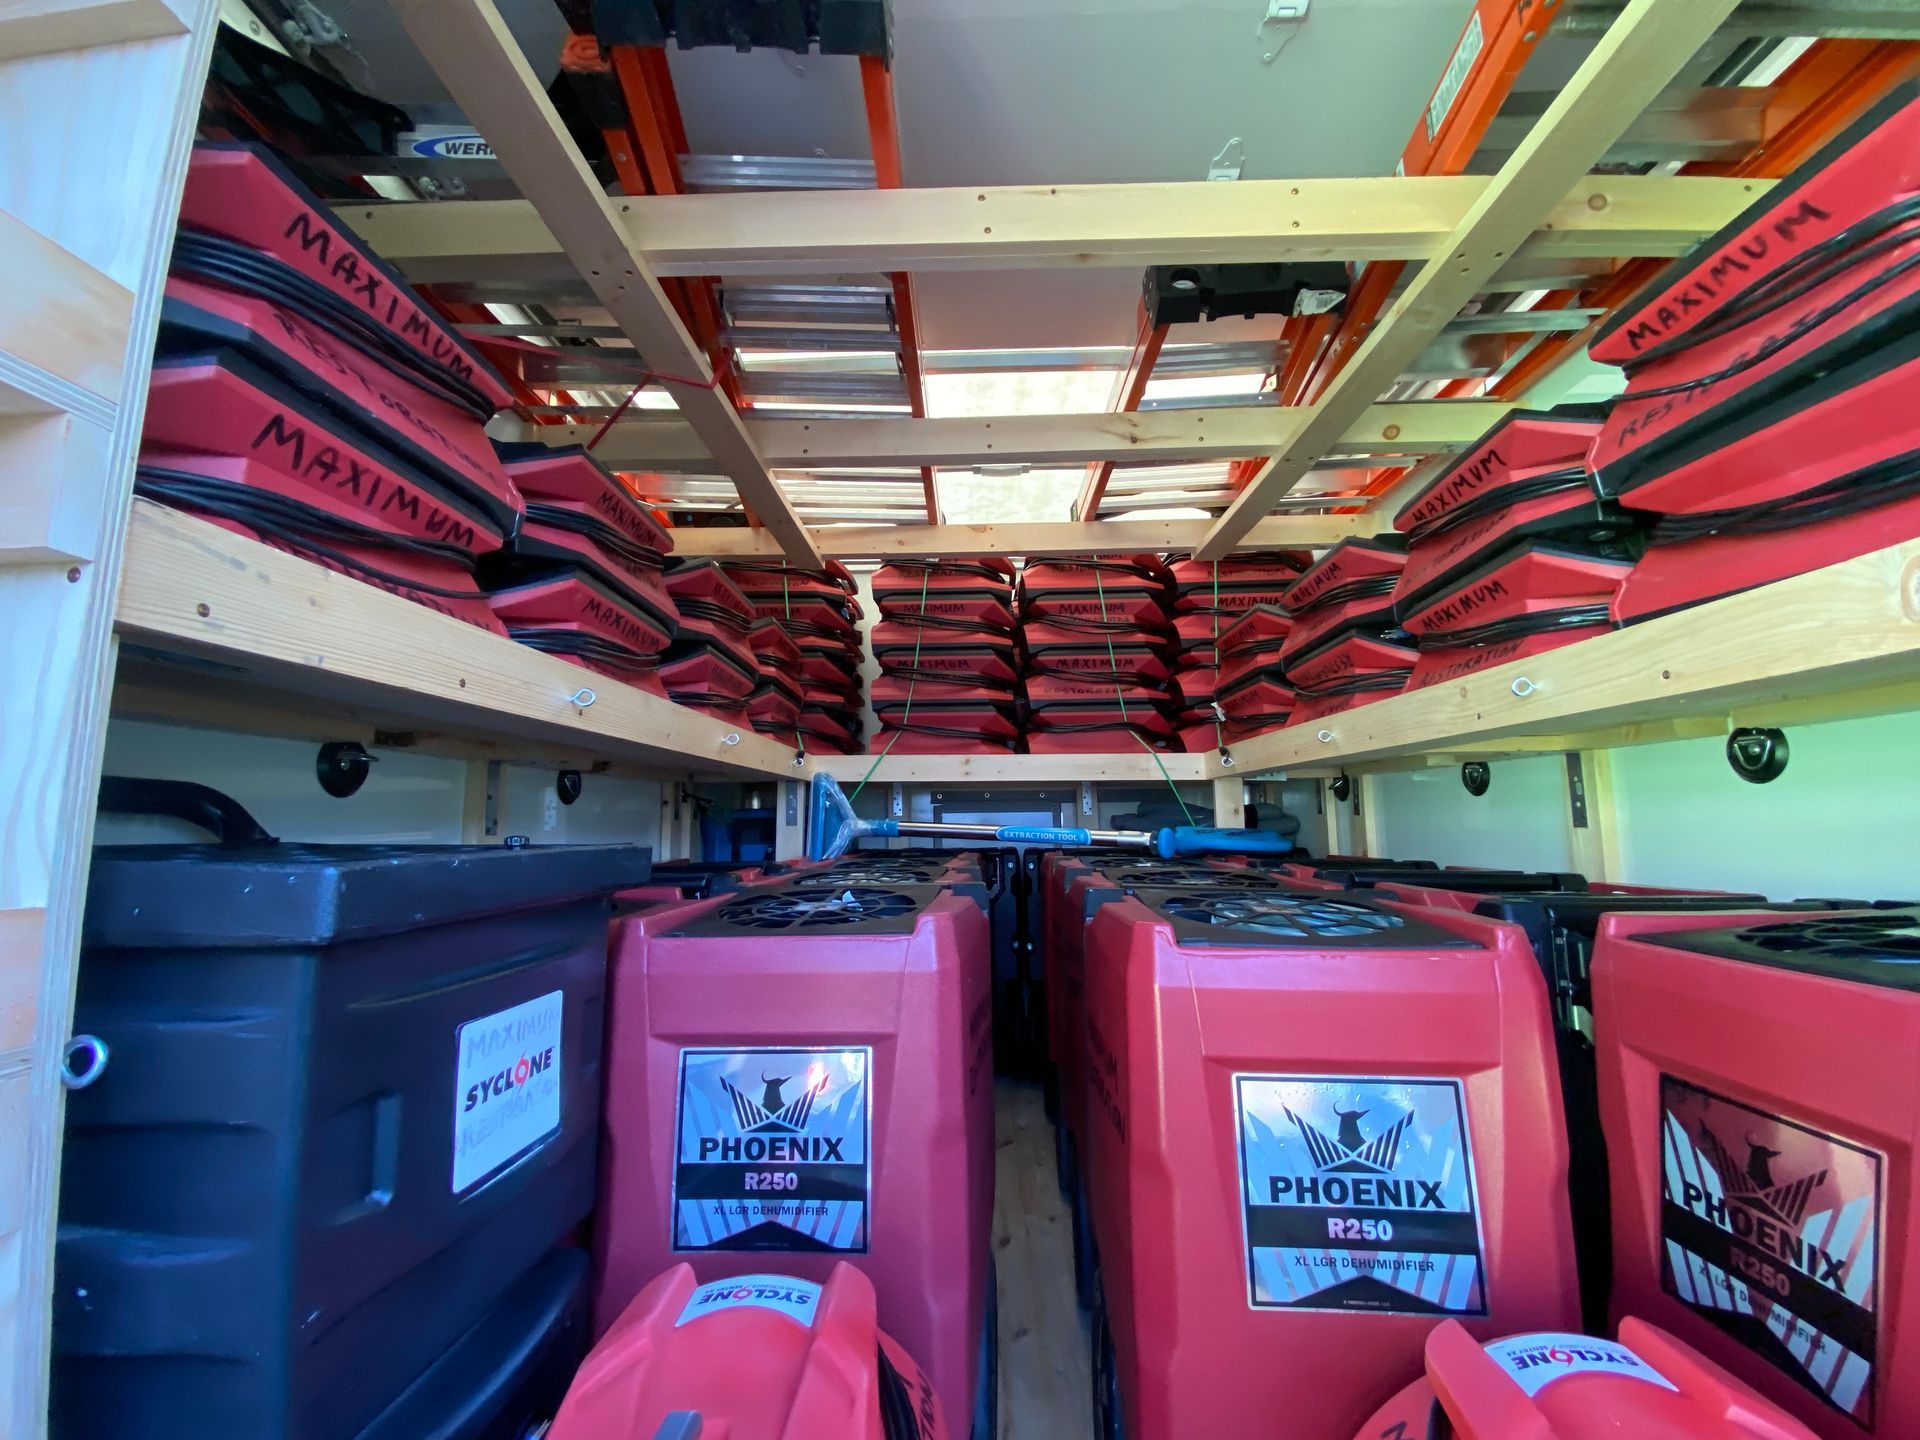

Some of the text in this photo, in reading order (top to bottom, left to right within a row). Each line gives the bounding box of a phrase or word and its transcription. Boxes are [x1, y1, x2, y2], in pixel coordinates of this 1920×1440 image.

[1625, 200, 1832, 350] MAXIMUM
[284, 212, 474, 380] MAXIMUM
[251, 413, 475, 548] MAXIMUM
[1411, 448, 1507, 523] MAXIMUM
[600, 489, 658, 548] MAXIMUM
[1291, 561, 1343, 603] MAXIMUM
[903, 603, 966, 614] MAXIMUM
[1058, 602, 1126, 616] MAXIMUM
[1421, 579, 1509, 632] MAXIMUM
[581, 597, 661, 651] MAXIMUM
[1056, 657, 1135, 670] MAXIMUM
[1004, 831, 1055, 840] EXTRACTION
[463, 1046, 554, 1113] SYCLONE
[700, 1136, 844, 1162] PHOENIX
[744, 1172, 798, 1191] R250
[1269, 1175, 1447, 1209] PHOENIX
[713, 1206, 829, 1216] XL LGR DEHUMIDIFIER
[1327, 1217, 1393, 1241] R250
[1682, 1178, 1847, 1295] PHOENIX
[1294, 1255, 1435, 1272] XL LGR DEHUMIDIFIER
[1730, 1246, 1791, 1297] R250
[697, 1286, 812, 1305] SYCLONE
[1510, 1348, 1640, 1371] SYCLONE
